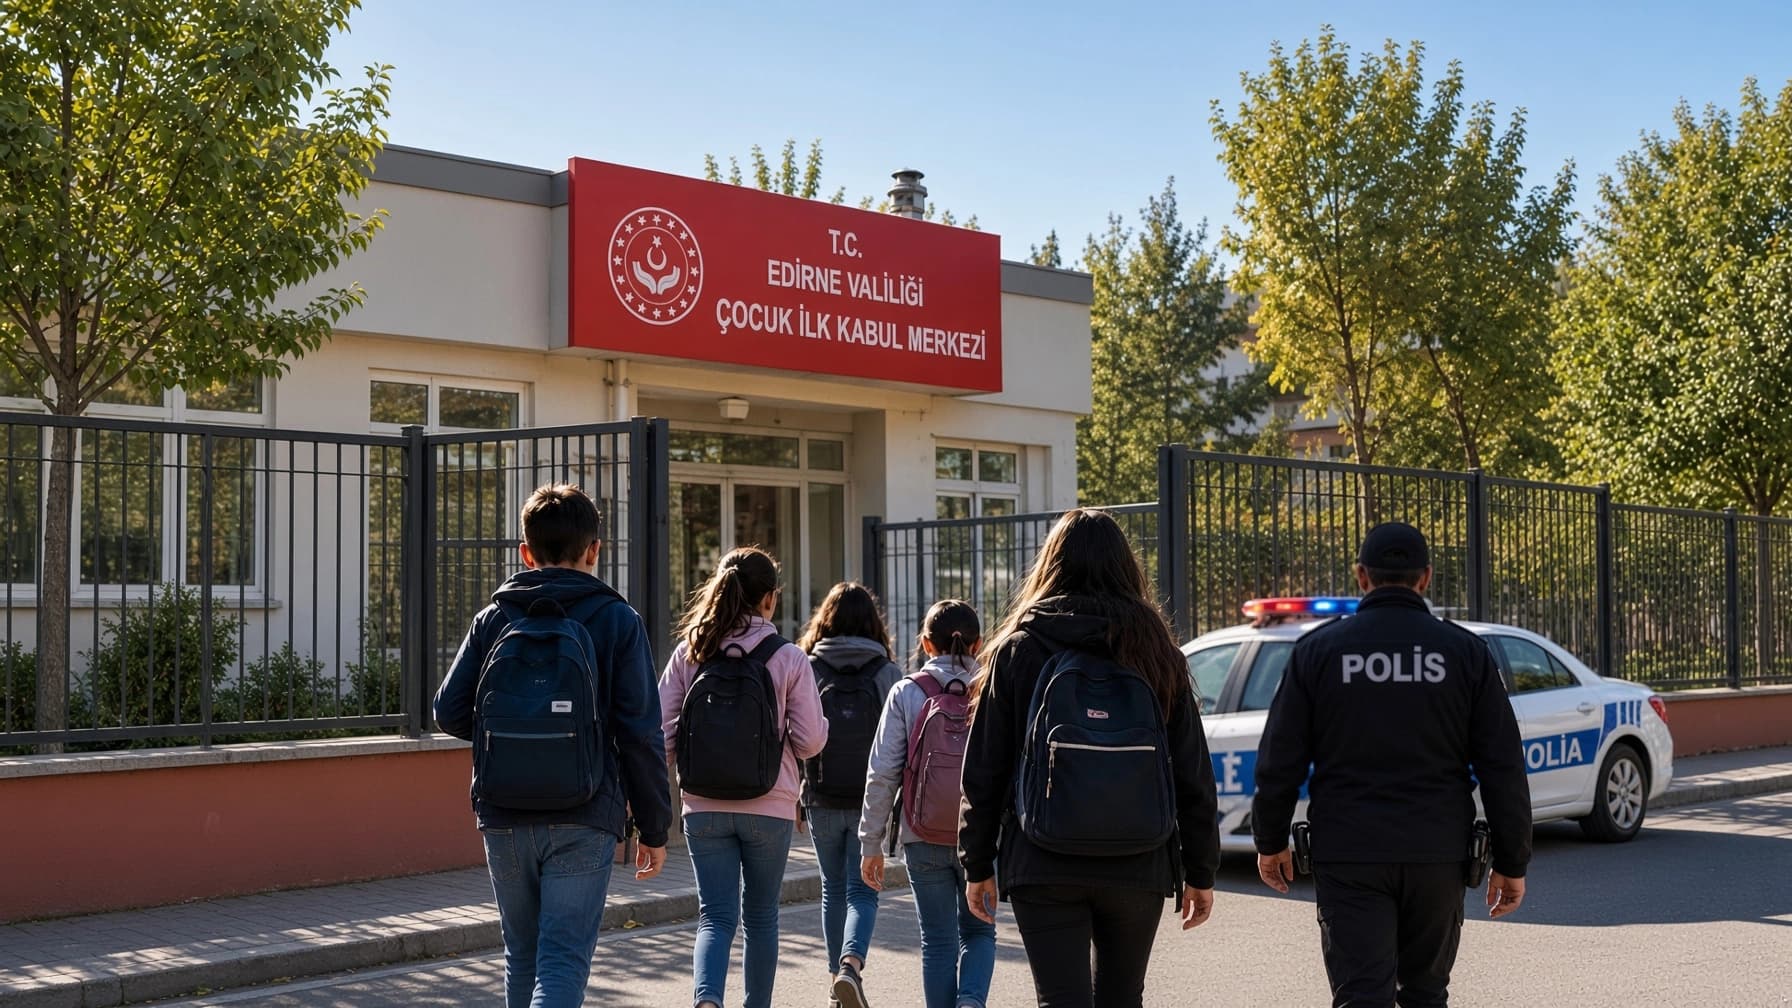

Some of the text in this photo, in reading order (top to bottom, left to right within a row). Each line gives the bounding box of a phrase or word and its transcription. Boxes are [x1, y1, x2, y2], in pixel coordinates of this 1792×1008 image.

[828, 228, 863, 258] T.C.
[767, 257, 924, 308] EDİRNE VALİLİĞİ
[715, 298, 987, 361] ÇOCUK İLK KABUL MERKEZİ
[1342, 645, 1447, 684] POLİS
[1522, 733, 1584, 770] OLİA
